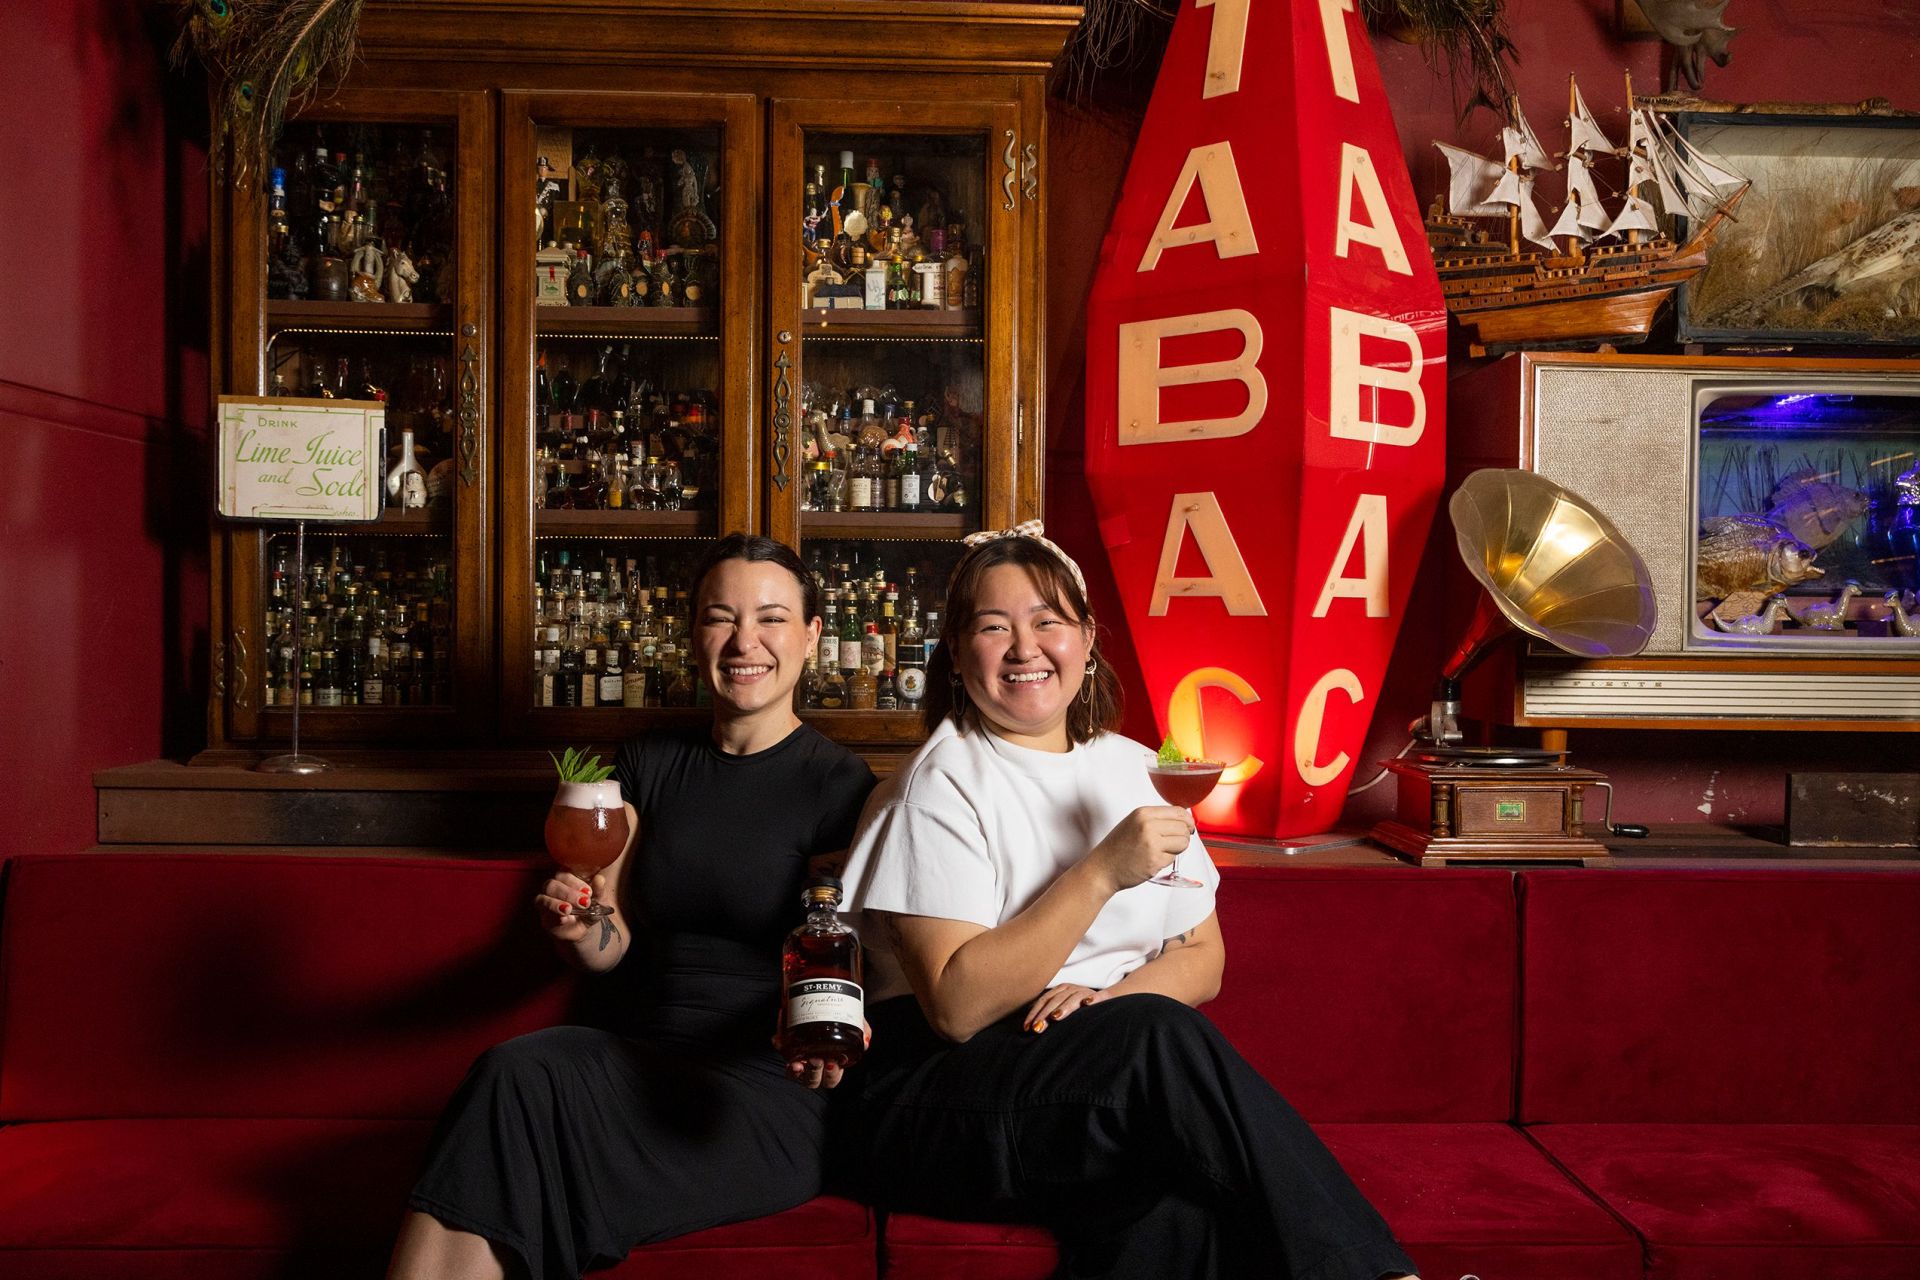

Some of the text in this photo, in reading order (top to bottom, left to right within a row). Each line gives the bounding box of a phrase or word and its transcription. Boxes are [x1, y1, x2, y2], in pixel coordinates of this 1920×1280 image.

[1119, 0, 1268, 786] TABAC
[1294, 0, 1426, 787] TABAC
[257, 416, 299, 428] DRINK
[236, 429, 363, 466] Lime Juice
[258, 468, 295, 484] and
